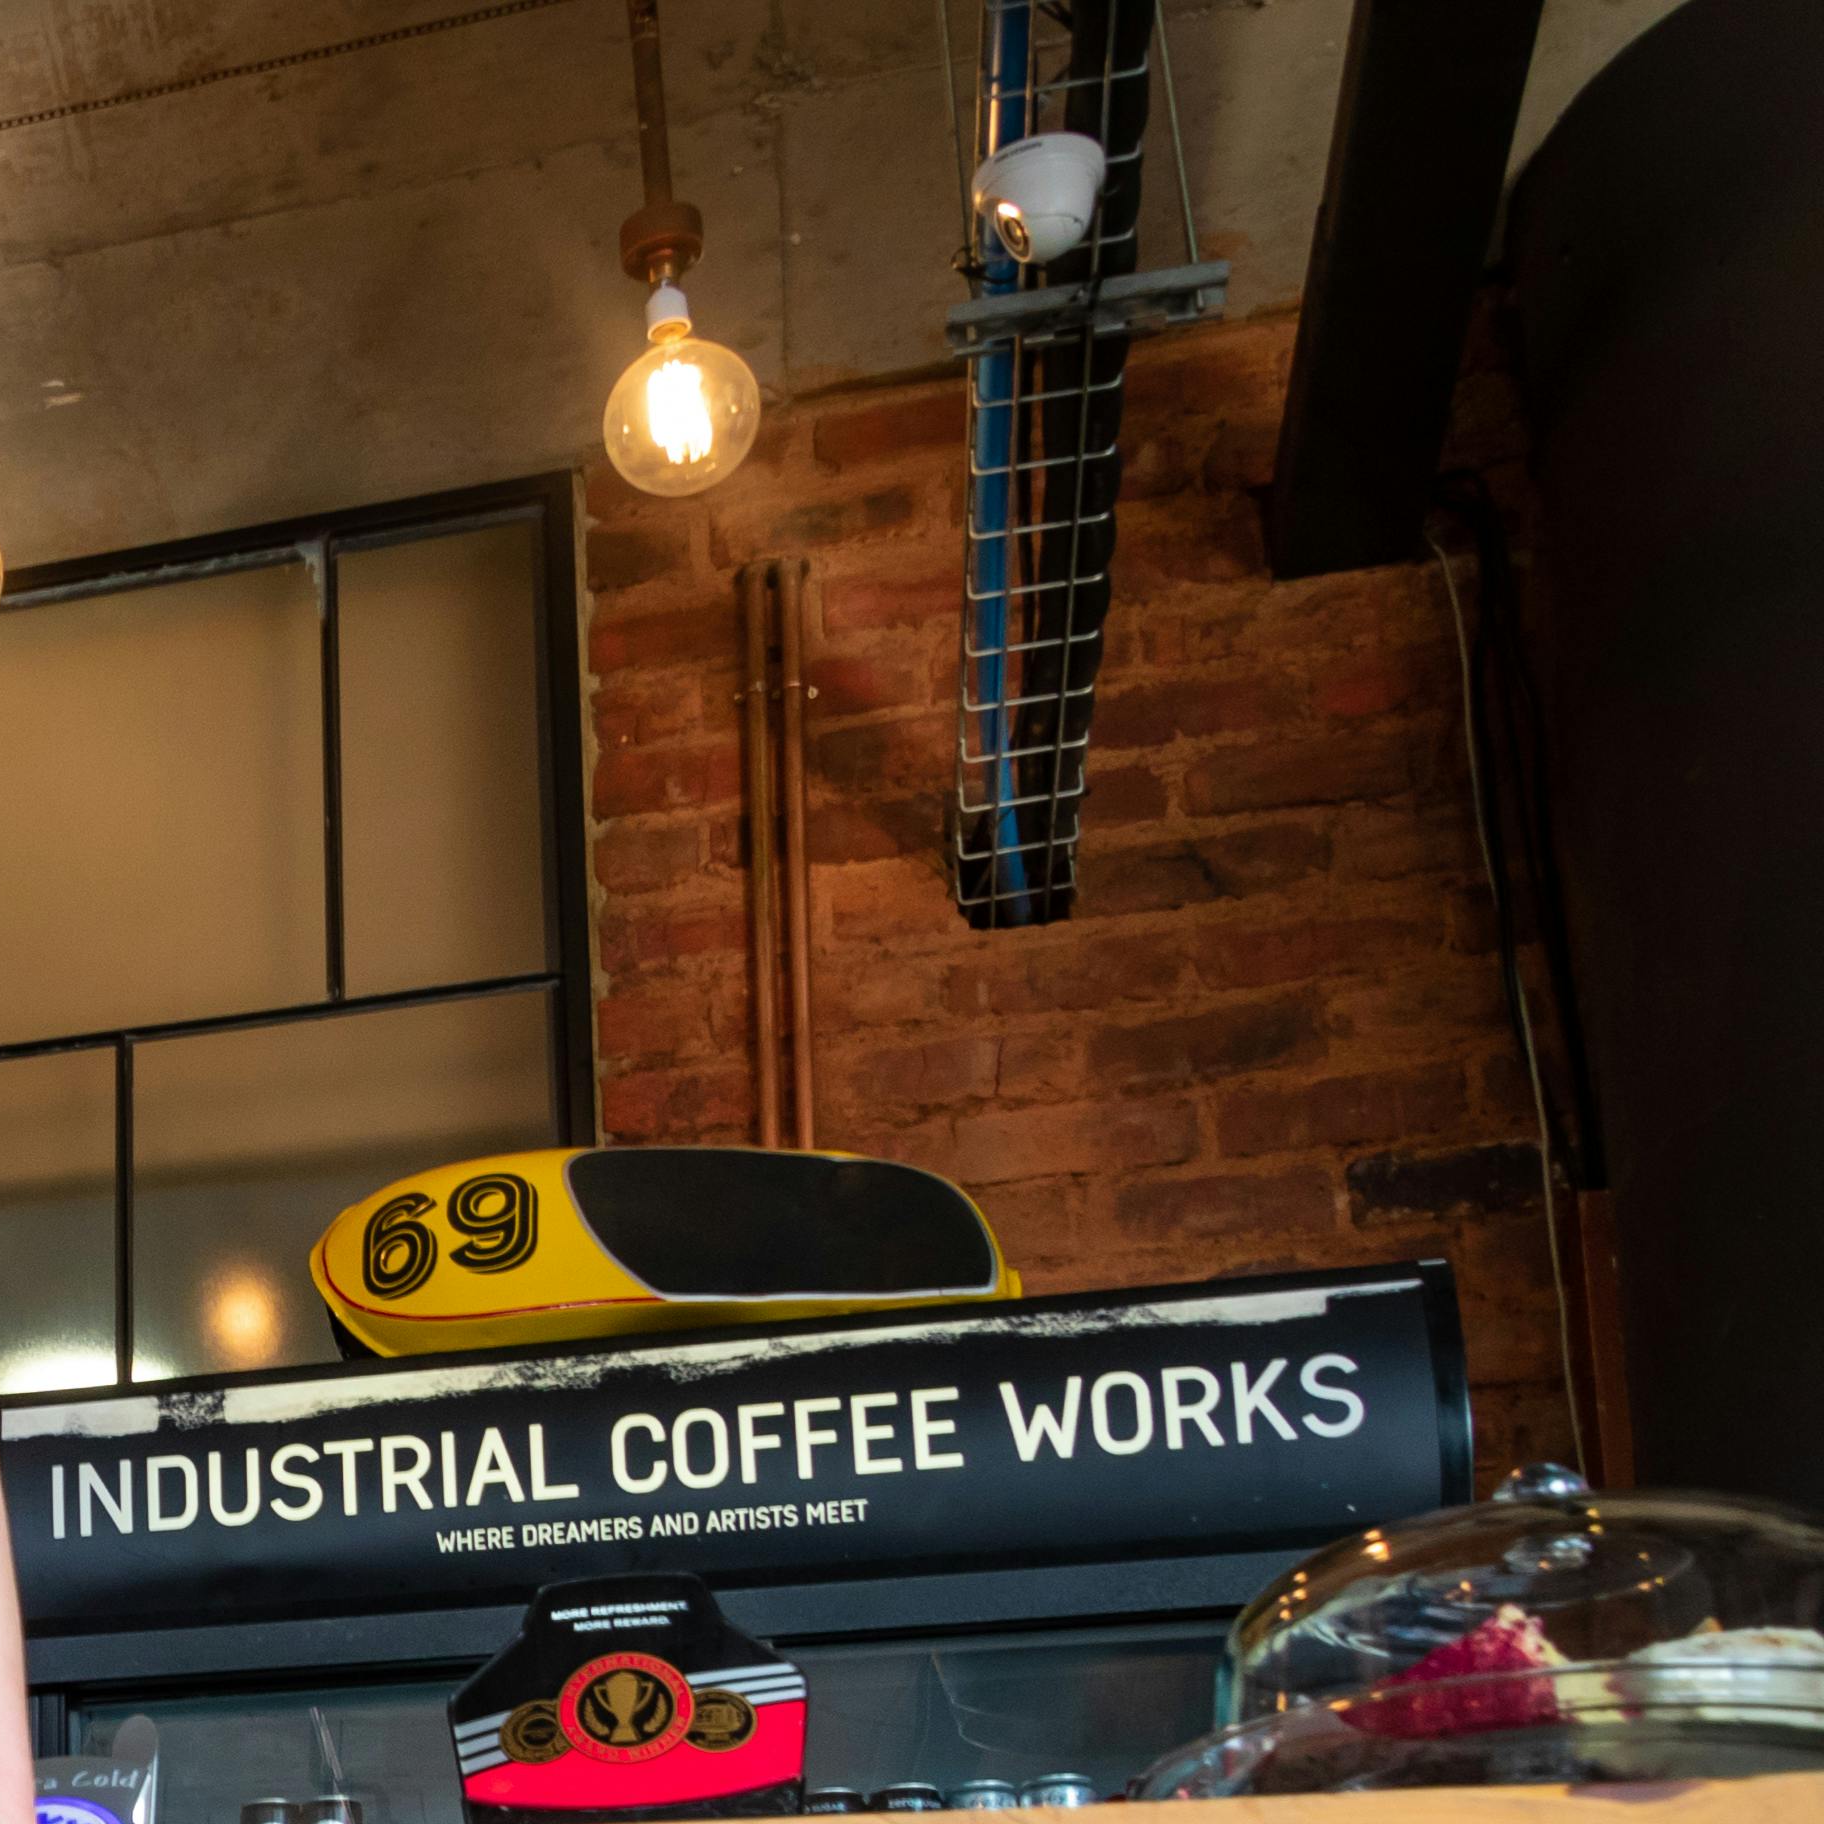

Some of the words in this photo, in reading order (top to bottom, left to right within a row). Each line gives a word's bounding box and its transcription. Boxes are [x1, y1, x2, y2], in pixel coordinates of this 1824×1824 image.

[362, 1173, 539, 1300] 69
[51, 1424, 579, 1540] INDUSTRIAL
[610, 1387, 964, 1494] COFFEE
[999, 1353, 1367, 1462] WORKS
[436, 1526, 515, 1553] WHERE
[522, 1516, 643, 1548] DREAMERS
[650, 1511, 699, 1537] AND
[706, 1504, 799, 1533] ARTISTS
[806, 1498, 868, 1526] MEET
[550, 1607, 589, 1621] MORE
[573, 1619, 611, 1632] MORE
[72, 1769, 139, 1789] Cold
